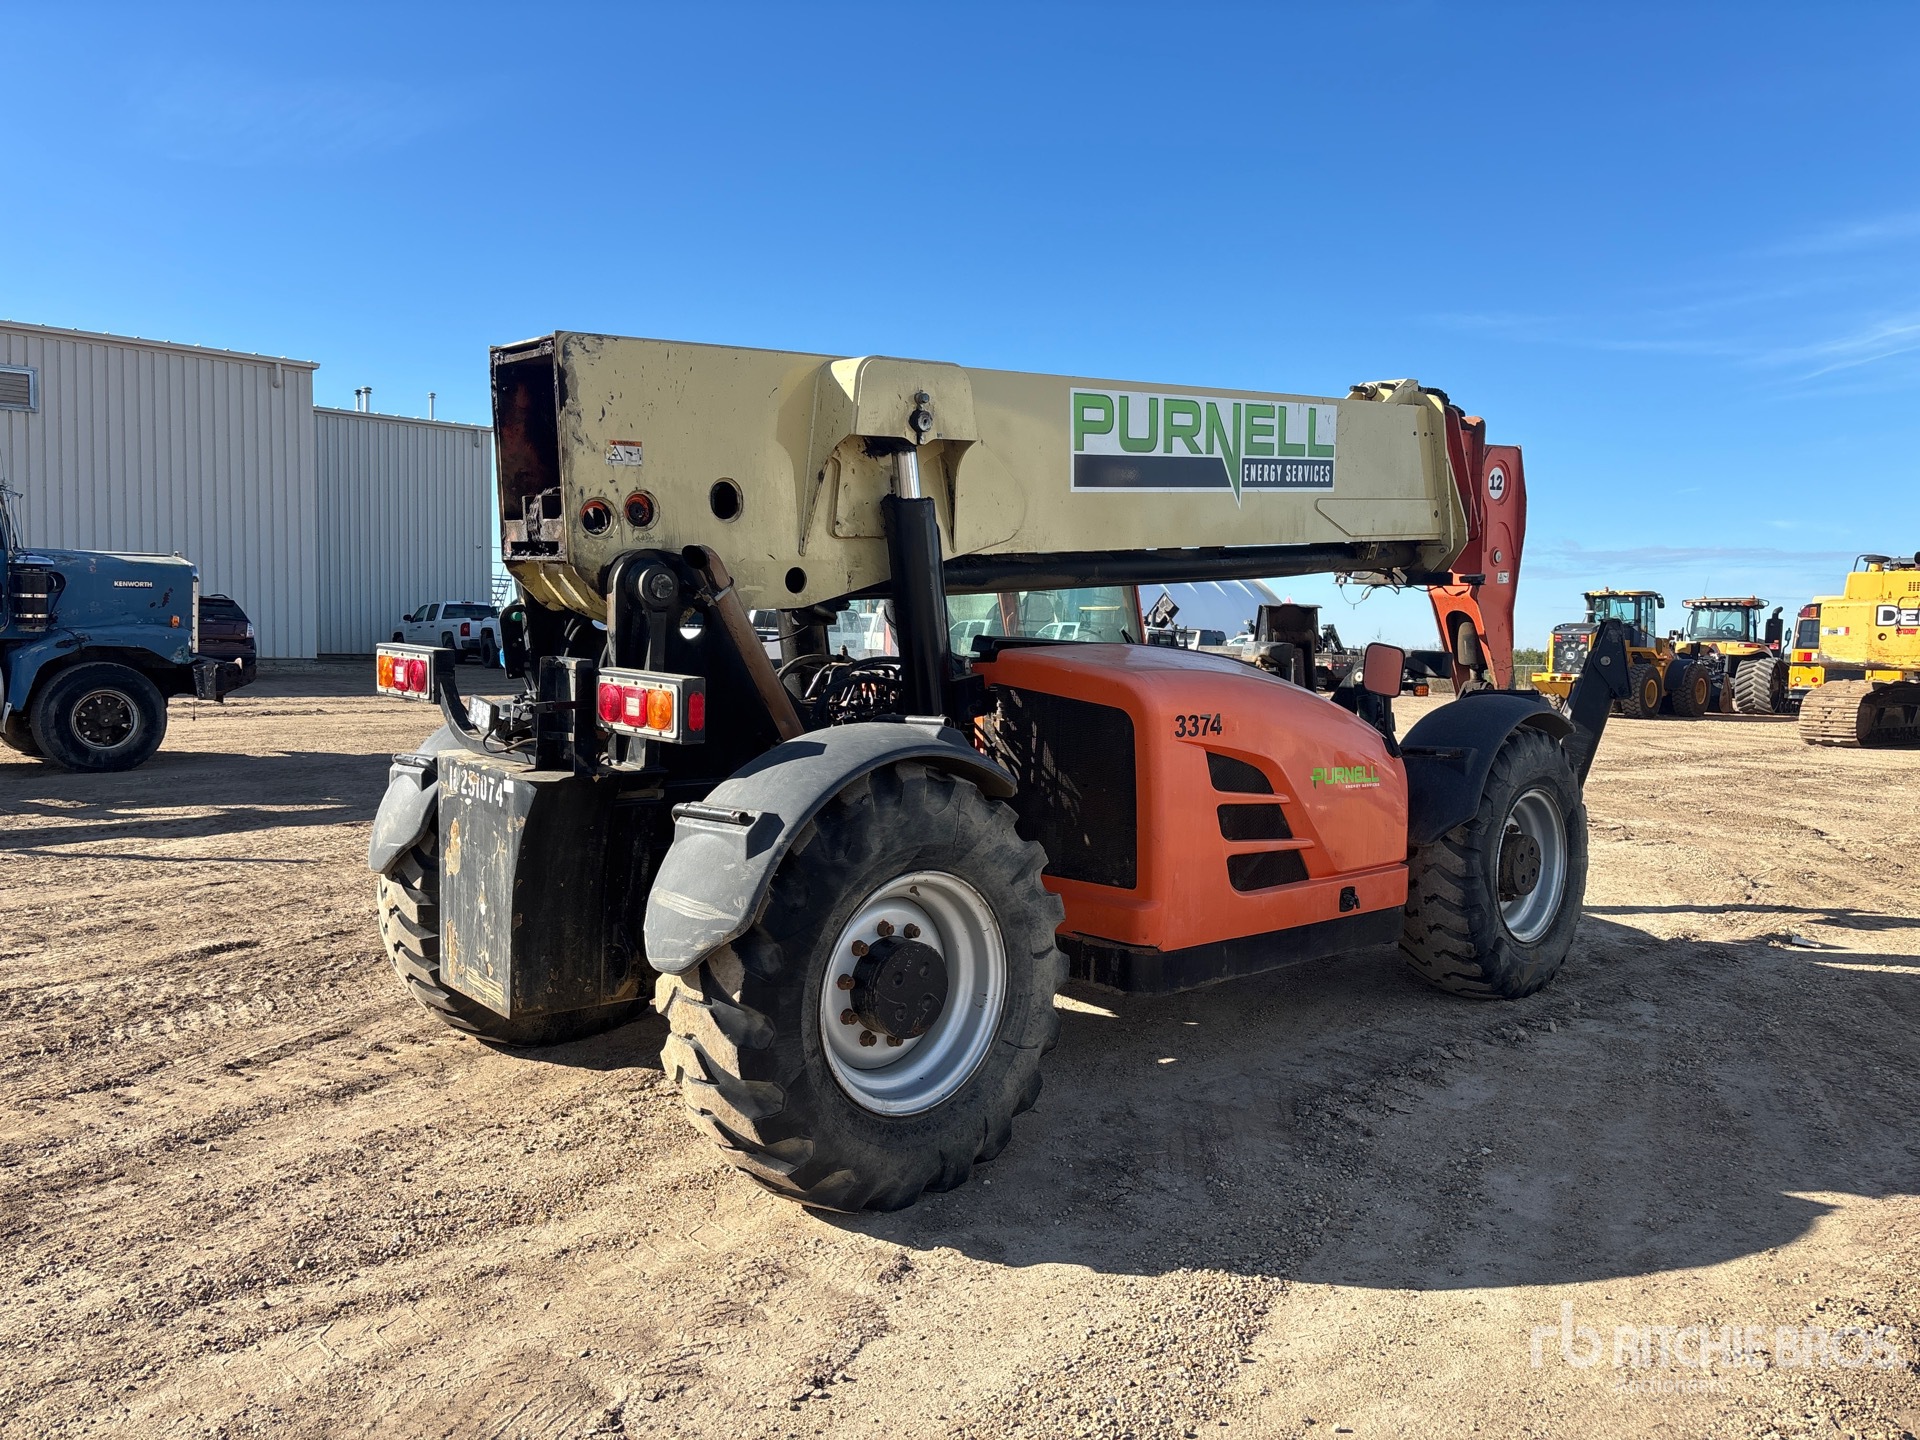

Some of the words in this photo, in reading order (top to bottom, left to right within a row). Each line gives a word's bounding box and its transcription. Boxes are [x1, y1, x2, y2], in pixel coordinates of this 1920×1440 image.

[1073, 392, 1335, 500] PURNELL
[1244, 463, 1282, 482] ENERGY
[1285, 464, 1330, 482] SERVICES
[1489, 474, 1503, 490] 12
[113, 580, 153, 588] KENWORTH
[1876, 605, 1920, 626] DE
[1174, 713, 1222, 738] 3374
[1310, 766, 1380, 789] PURNELL
